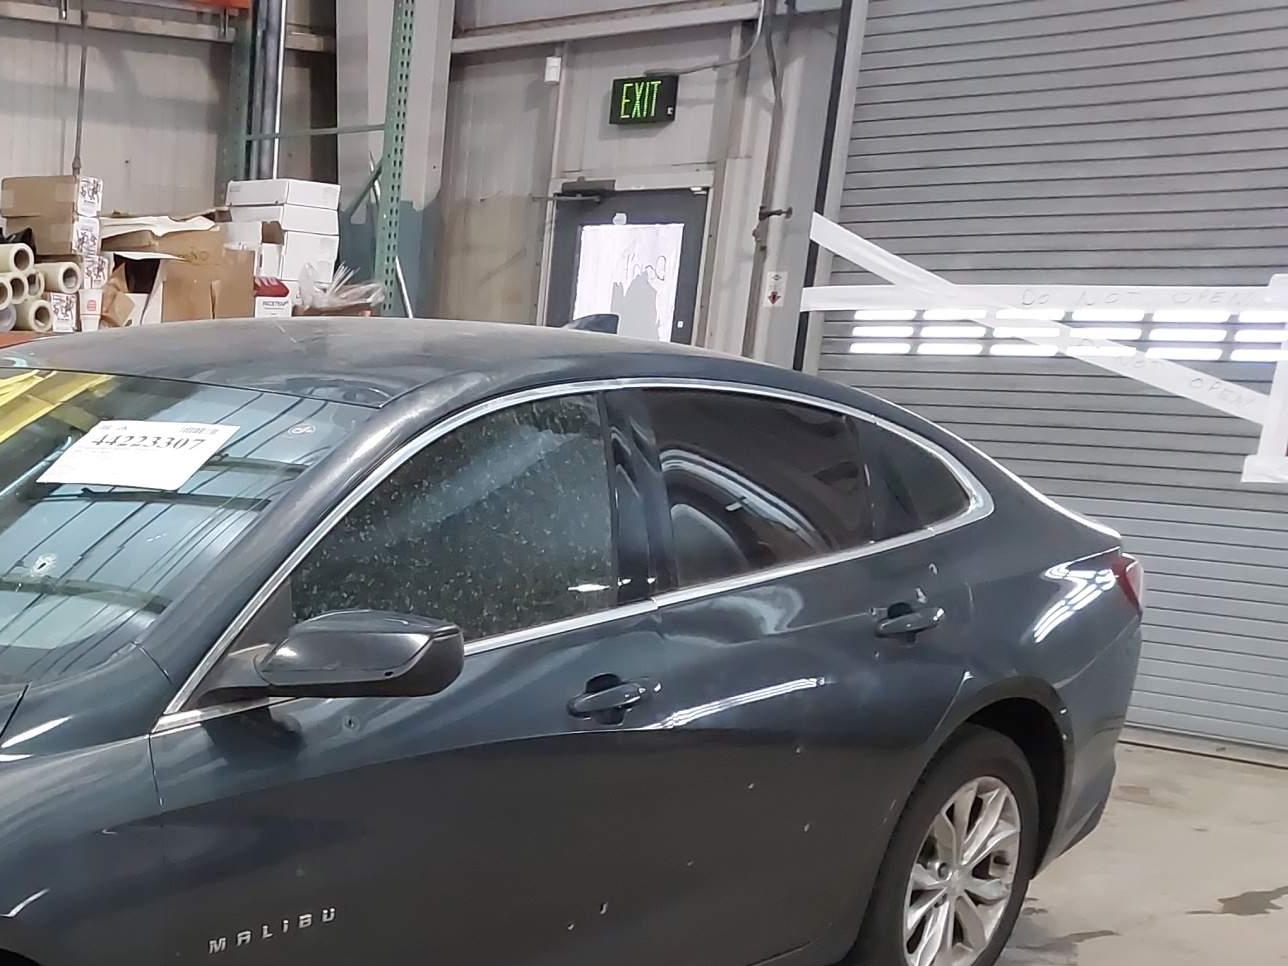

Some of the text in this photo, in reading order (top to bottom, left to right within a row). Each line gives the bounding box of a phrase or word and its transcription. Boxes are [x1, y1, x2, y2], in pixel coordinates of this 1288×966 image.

[620, 81, 661, 118] EXIT
[1073, 290, 1141, 306] NOT
[1172, 290, 1255, 304] OPEN
[1188, 376, 1256, 408] OPEN
[92, 433, 206, 450] 44223307
[209, 907, 335, 954] MALIBU
